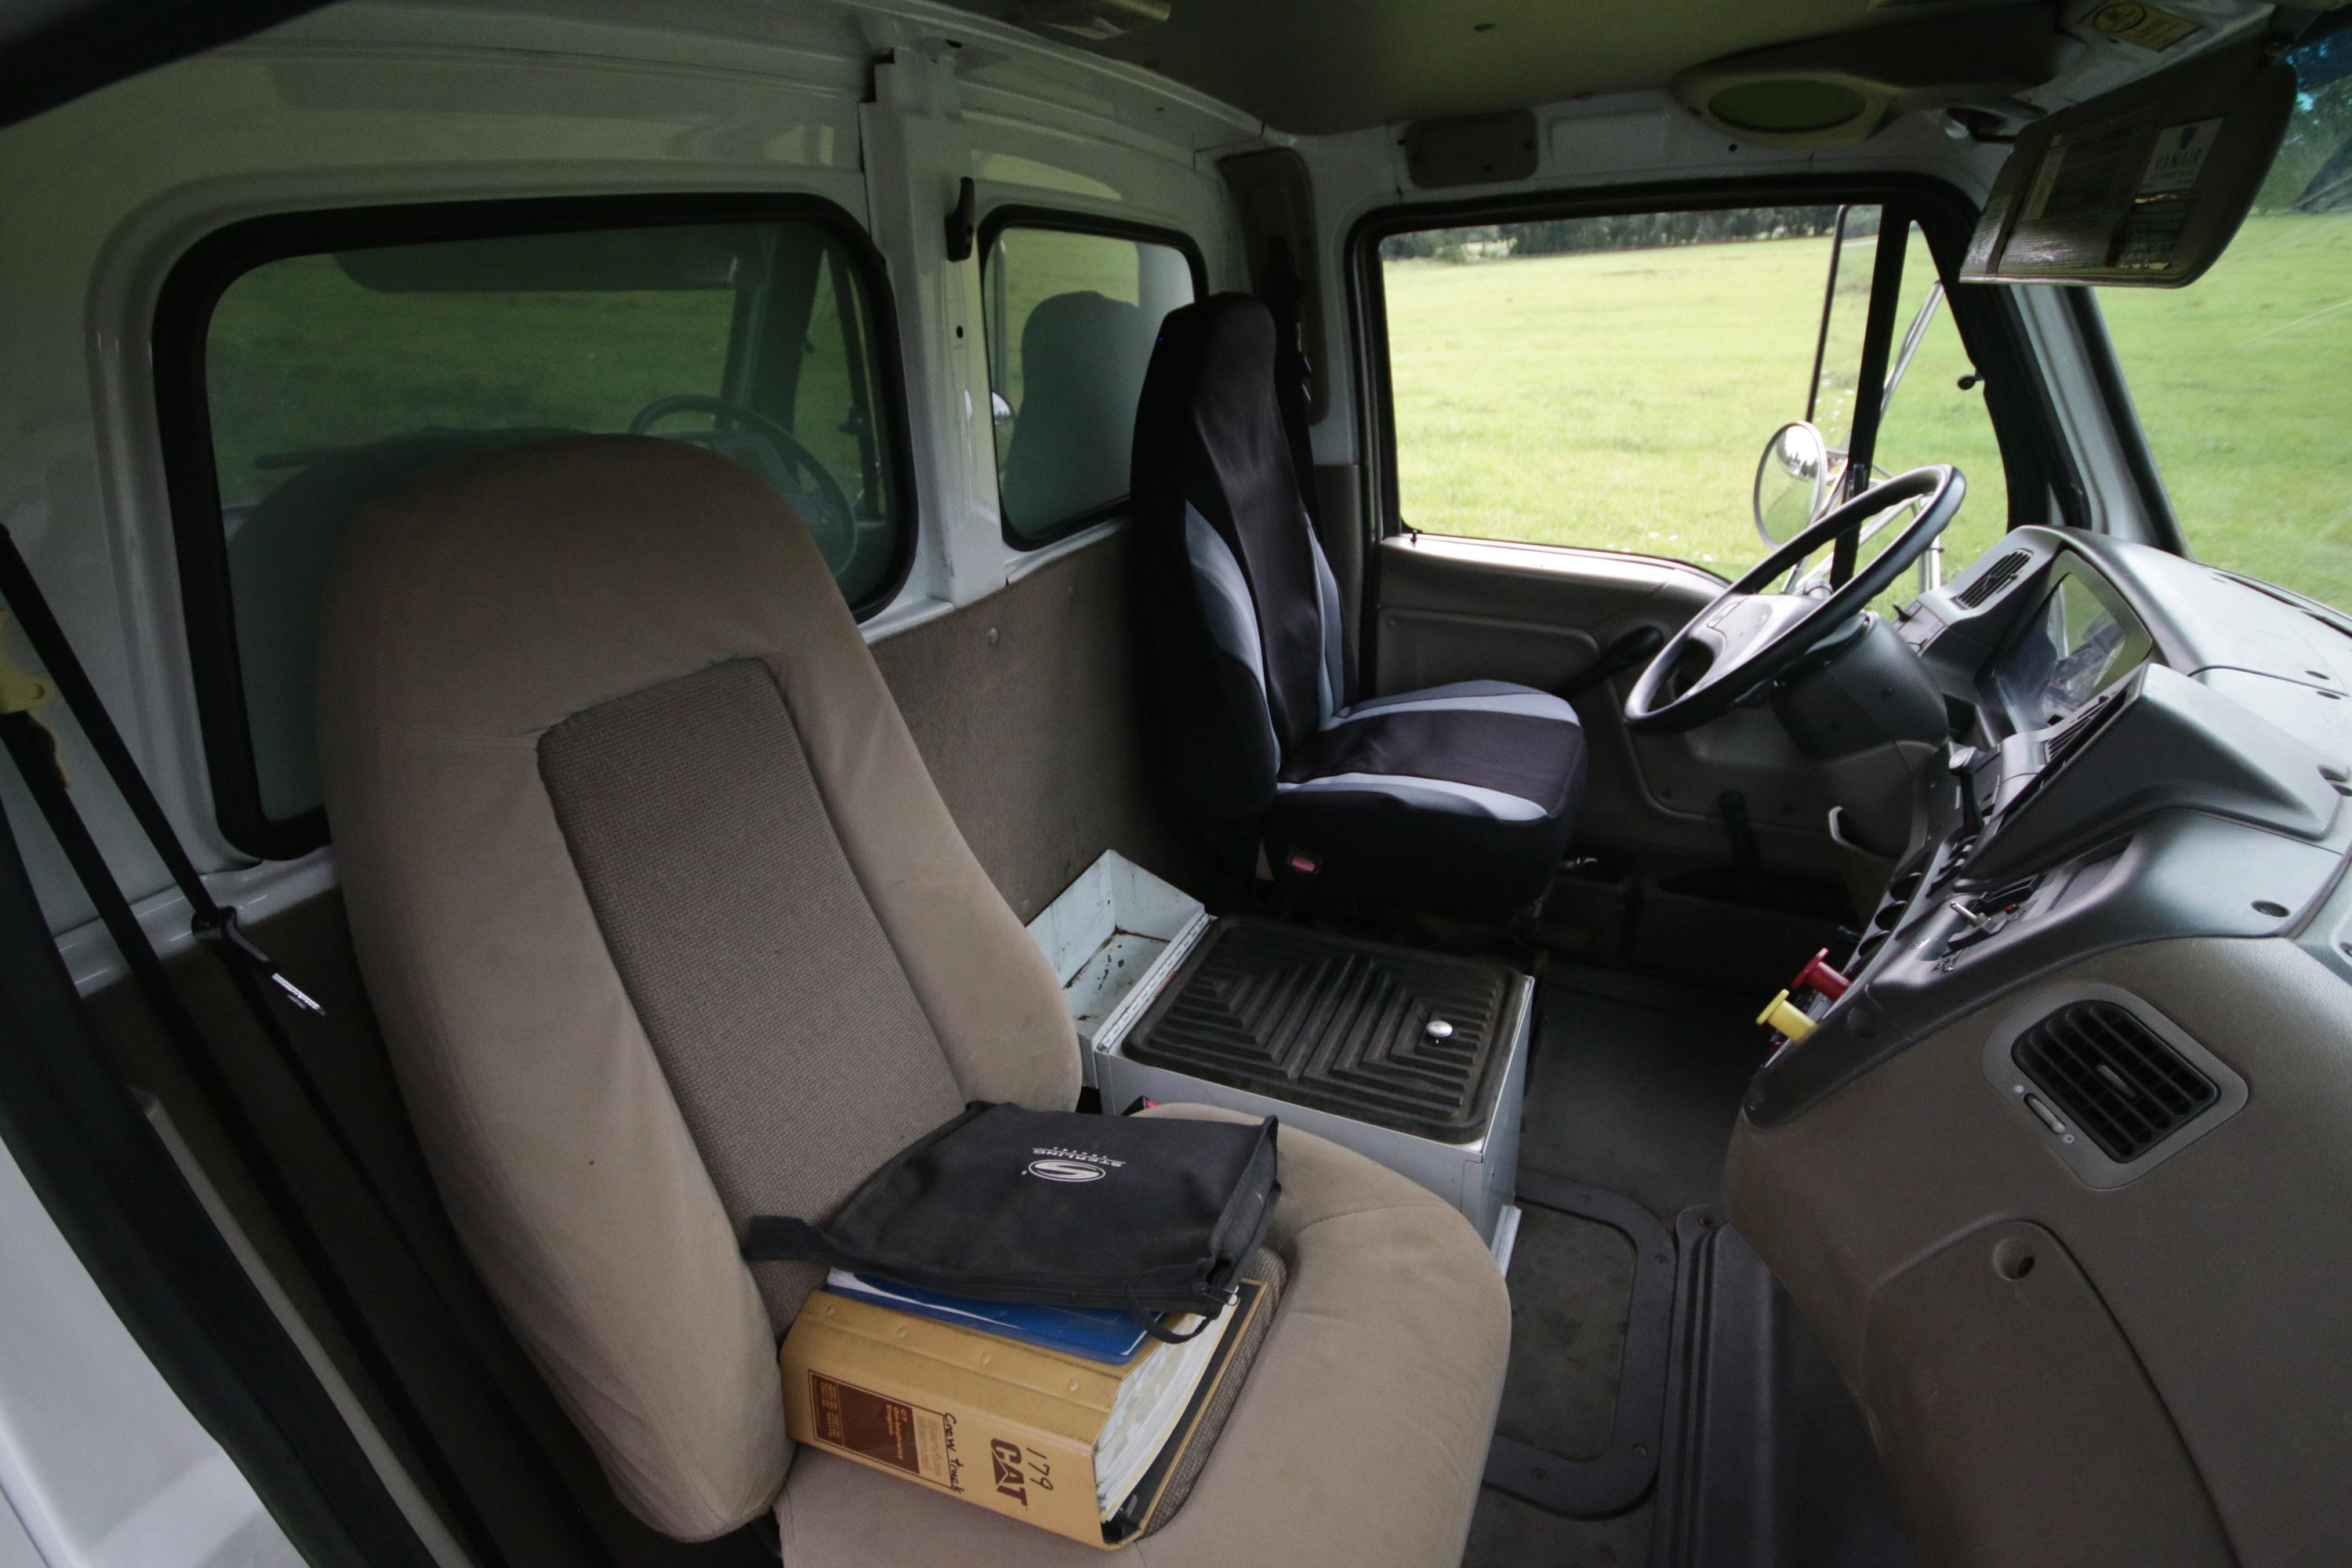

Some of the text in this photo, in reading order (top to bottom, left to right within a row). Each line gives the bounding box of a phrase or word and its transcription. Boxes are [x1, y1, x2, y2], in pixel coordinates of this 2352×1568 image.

[1033, 1149, 1122, 1167] STERLING
[944, 1412, 957, 1453] Crew
[990, 1438, 1029, 1507] CAT
[1025, 1447, 1054, 1490] 179
